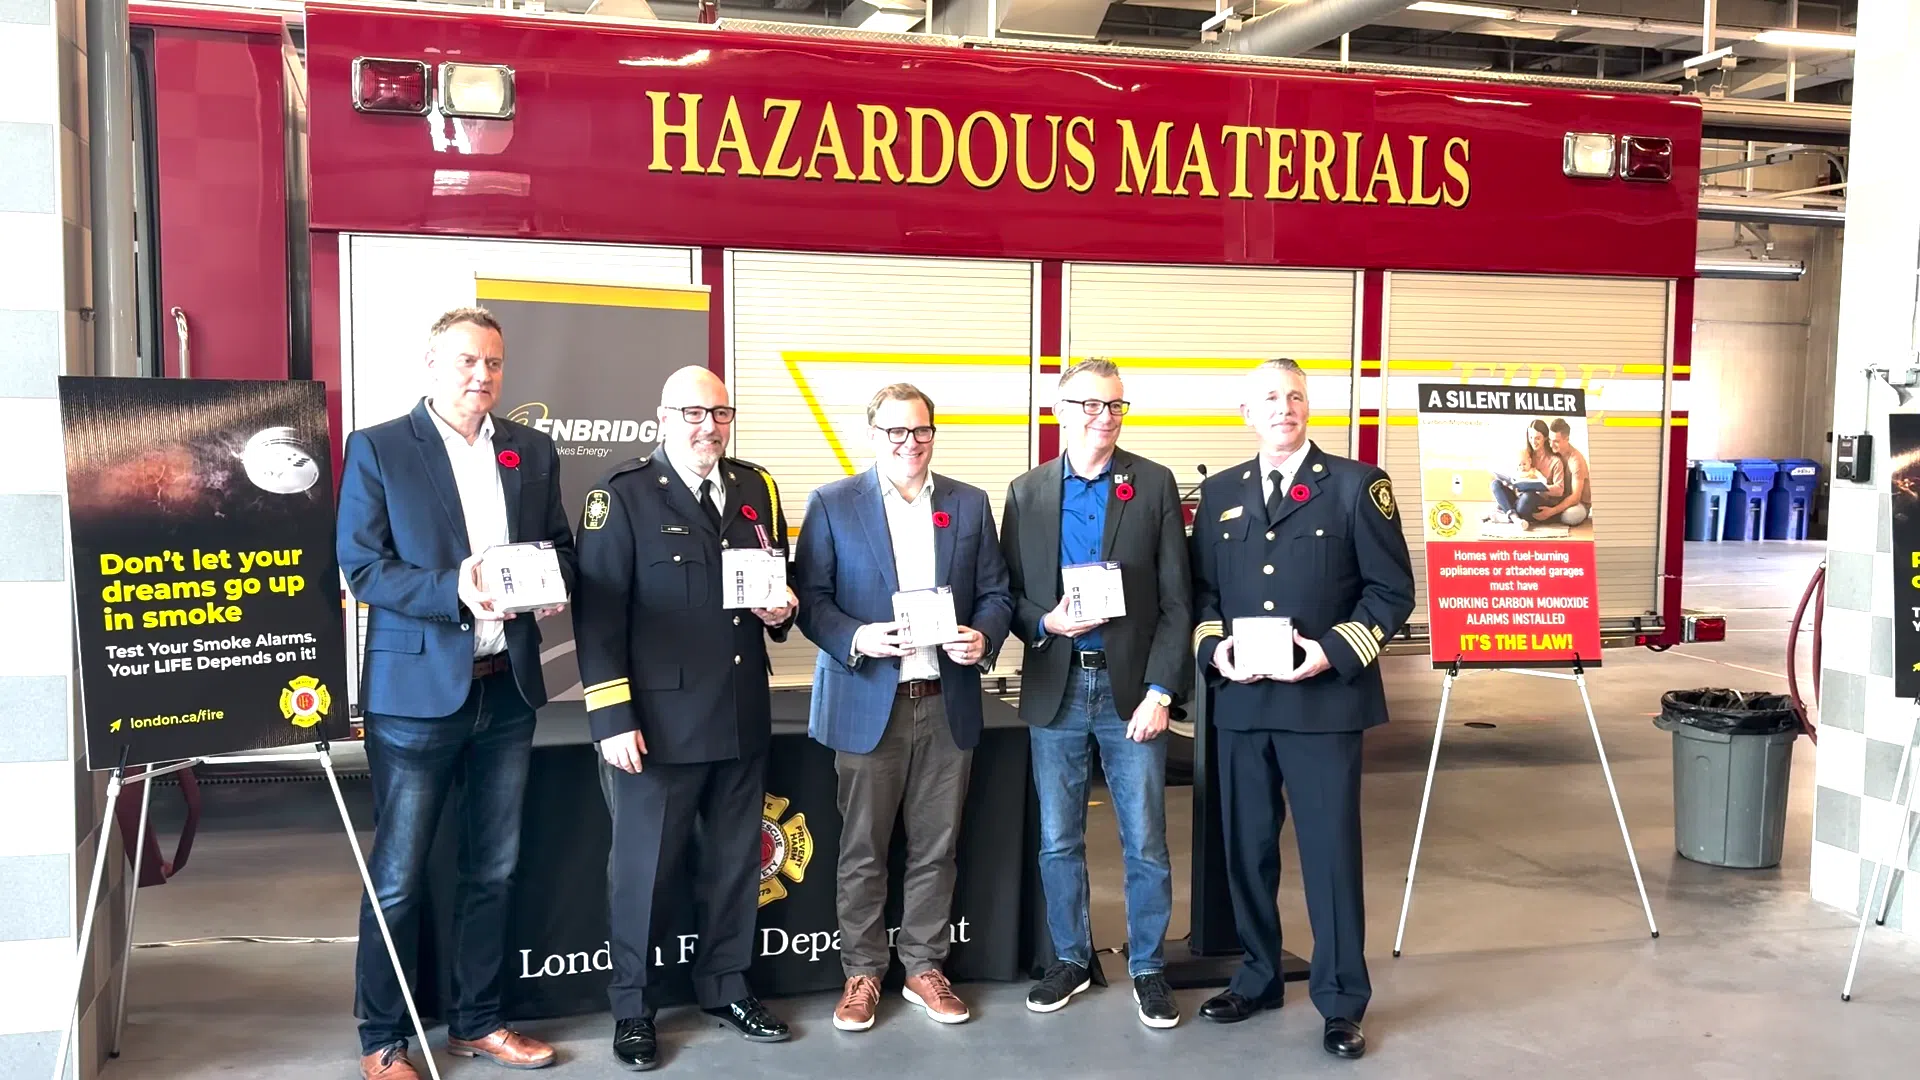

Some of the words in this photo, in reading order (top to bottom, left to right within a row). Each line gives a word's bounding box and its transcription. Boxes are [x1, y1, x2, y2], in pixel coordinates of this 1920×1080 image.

[645, 90, 1094, 192] HAZARDOUS
[1116, 118, 1471, 207] MATERIALS
[1428, 390, 1443, 408] A
[1446, 390, 1510, 410] SILENT
[1515, 392, 1577, 412] KILLER
[534, 418, 661, 443] ENBRIDG
[556, 446, 575, 456] akes
[577, 446, 609, 457] Energy
[101, 550, 185, 576] Don't
[193, 548, 231, 571] let
[240, 546, 303, 573] your
[1454, 550, 1487, 562] Homes
[1489, 550, 1510, 562] with
[1512, 550, 1570, 564] fuel-burning
[1440, 565, 1490, 578] appliances
[1493, 567, 1502, 576] or
[1505, 565, 1547, 577] attached
[1549, 567, 1585, 579] garages
[102, 579, 216, 604] dreams
[224, 577, 261, 601] go
[269, 573, 305, 597] up
[1490, 580, 1515, 592] must
[1517, 580, 1539, 592] have
[1438, 596, 1489, 609] WORKING
[1491, 596, 1534, 609] CARBON
[1537, 596, 1589, 609] MONOXIDE
[104, 607, 134, 632] in
[142, 602, 243, 629] smoke
[1466, 612, 1509, 625] ALARMS
[1512, 612, 1566, 625] INSTALLED
[105, 644, 144, 660] Test
[148, 640, 189, 656] Your
[193, 634, 252, 653] Smoke
[255, 630, 317, 648] Alarms.
[1460, 633, 1491, 651] IT'S
[1496, 633, 1527, 651] THE
[1531, 633, 1574, 650] LAW!
[107, 661, 150, 678] Your
[154, 657, 193, 674] LIFE
[196, 651, 272, 671] Depends
[276, 650, 297, 663] on
[300, 646, 317, 661] it!
[130, 708, 225, 731] london.ca/fire
[795, 825, 806, 869] PREVENT
